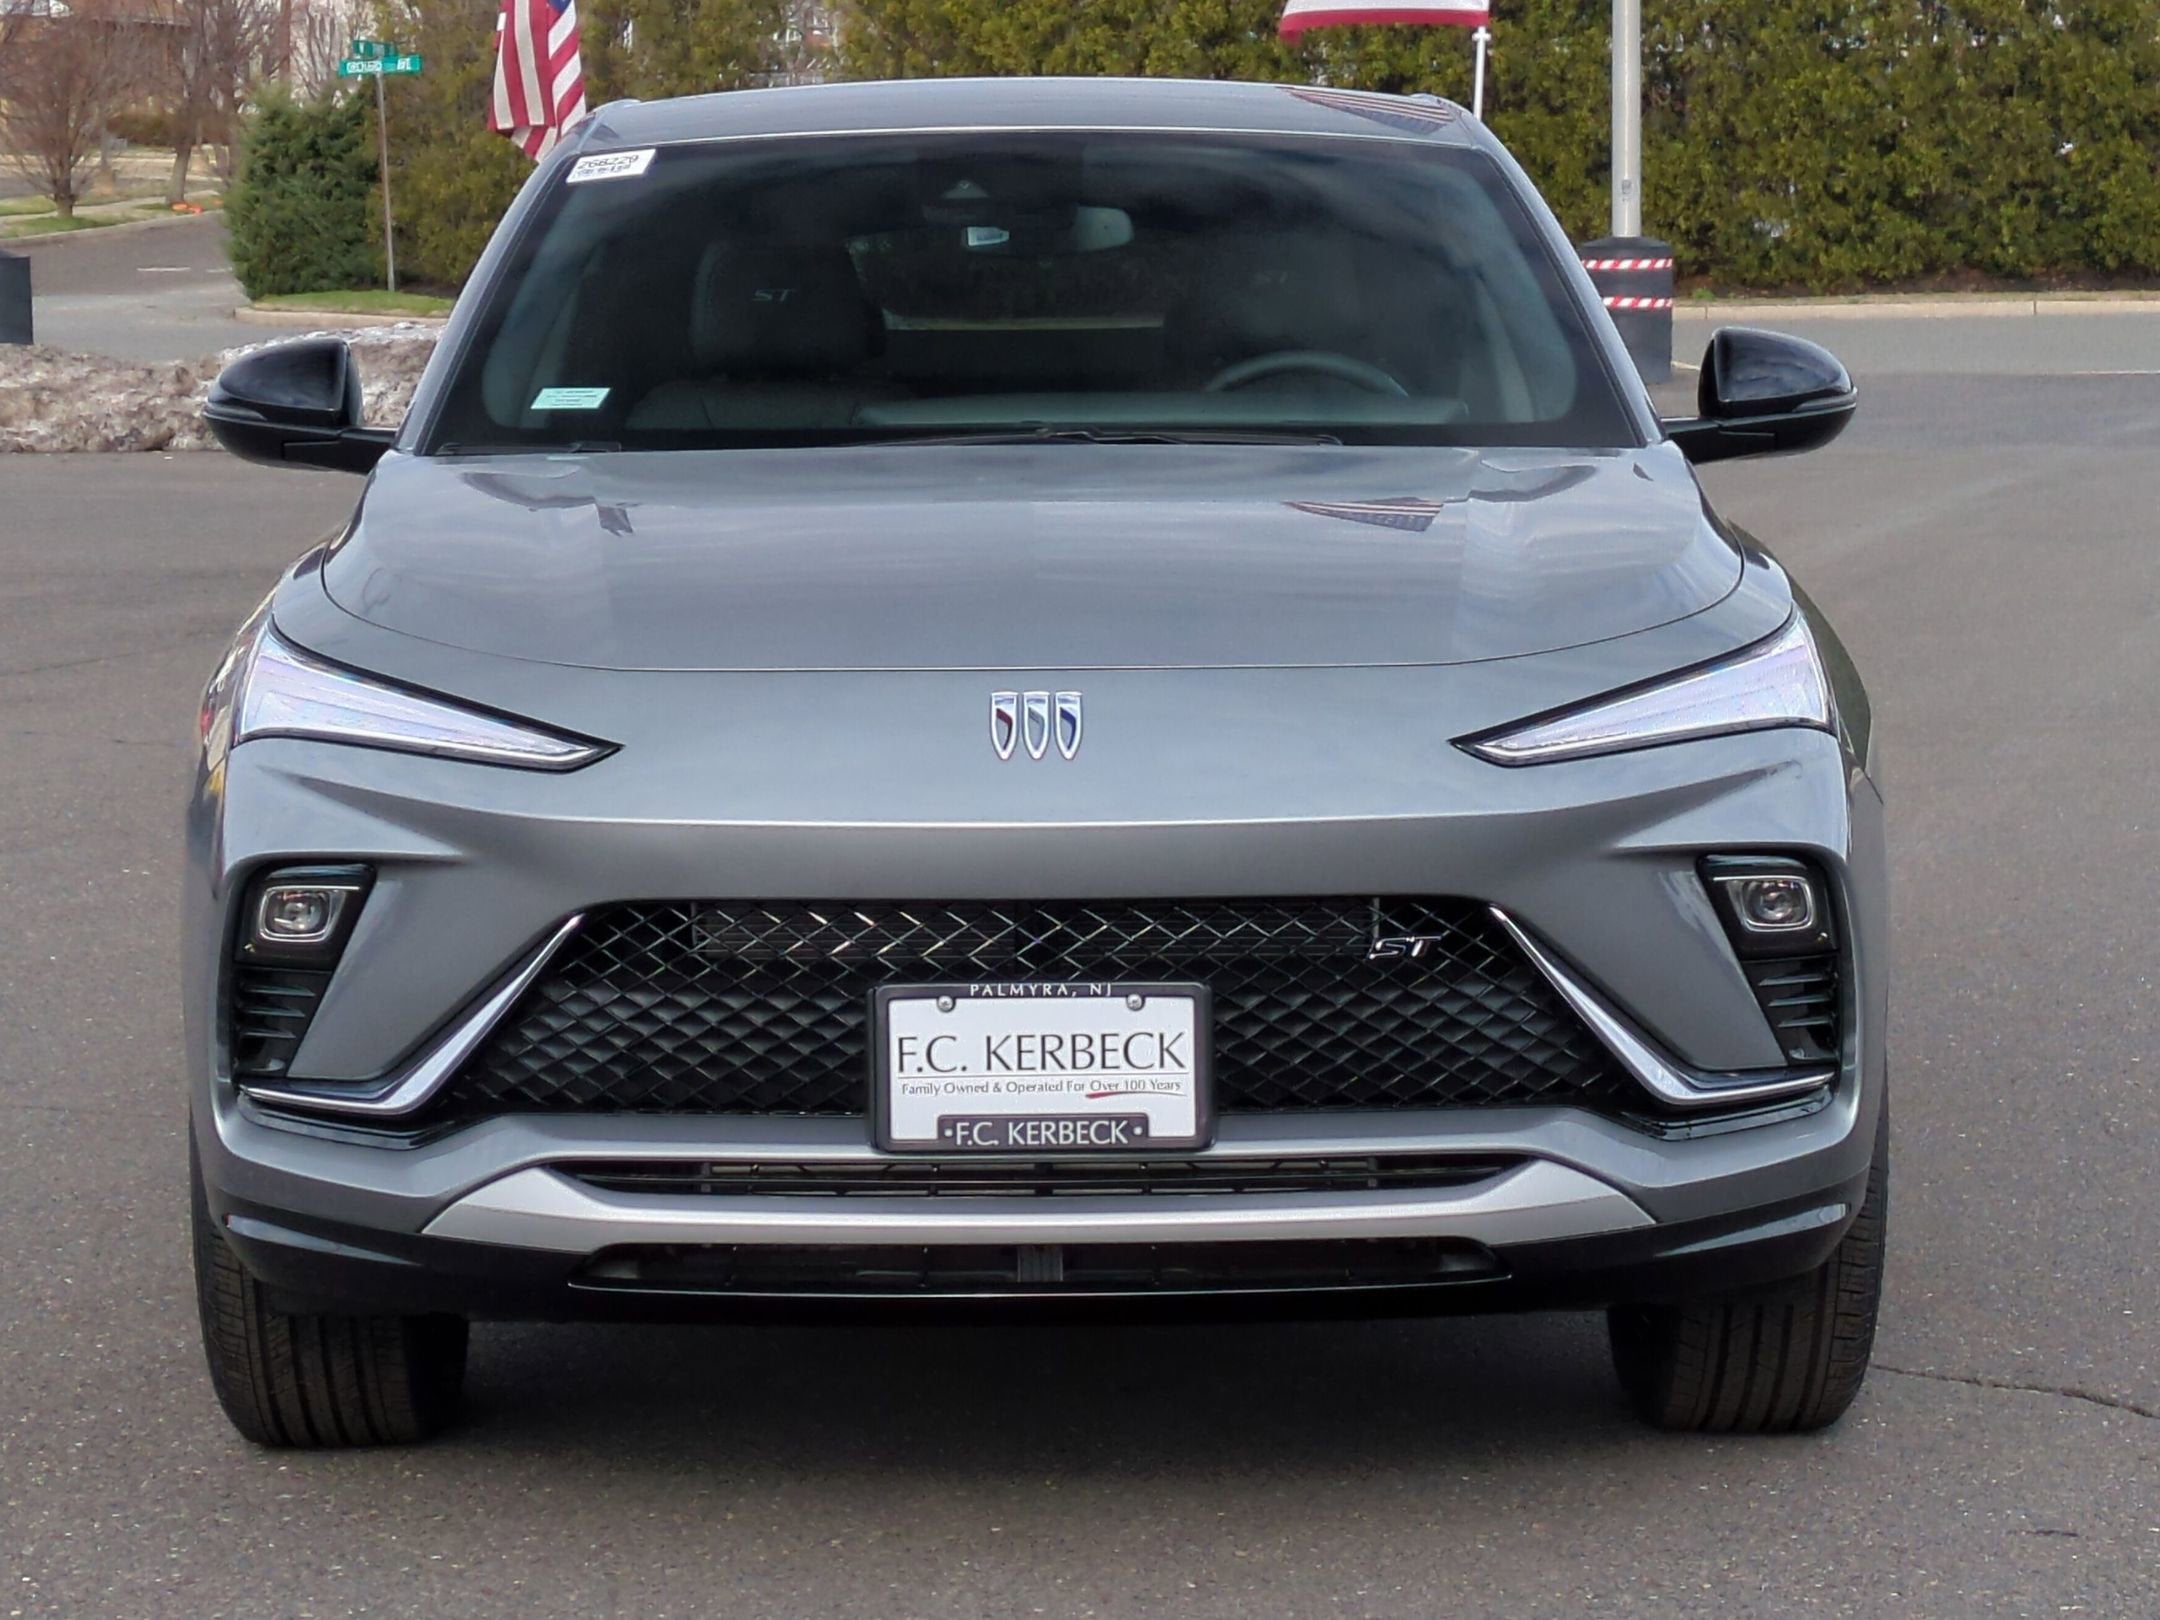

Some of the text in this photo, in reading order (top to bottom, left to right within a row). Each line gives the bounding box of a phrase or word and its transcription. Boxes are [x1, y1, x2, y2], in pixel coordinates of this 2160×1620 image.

[752, 288, 798, 302] ST
[1369, 935, 1441, 960] ST
[970, 983, 1112, 997] PALMYRA, NJ
[898, 1032, 1185, 1072] F.C. KERBECK
[902, 1079, 1182, 1096] Family Owned & Operated For Over 100 Years
[955, 1120, 1129, 1146] F.C. KERBECK
